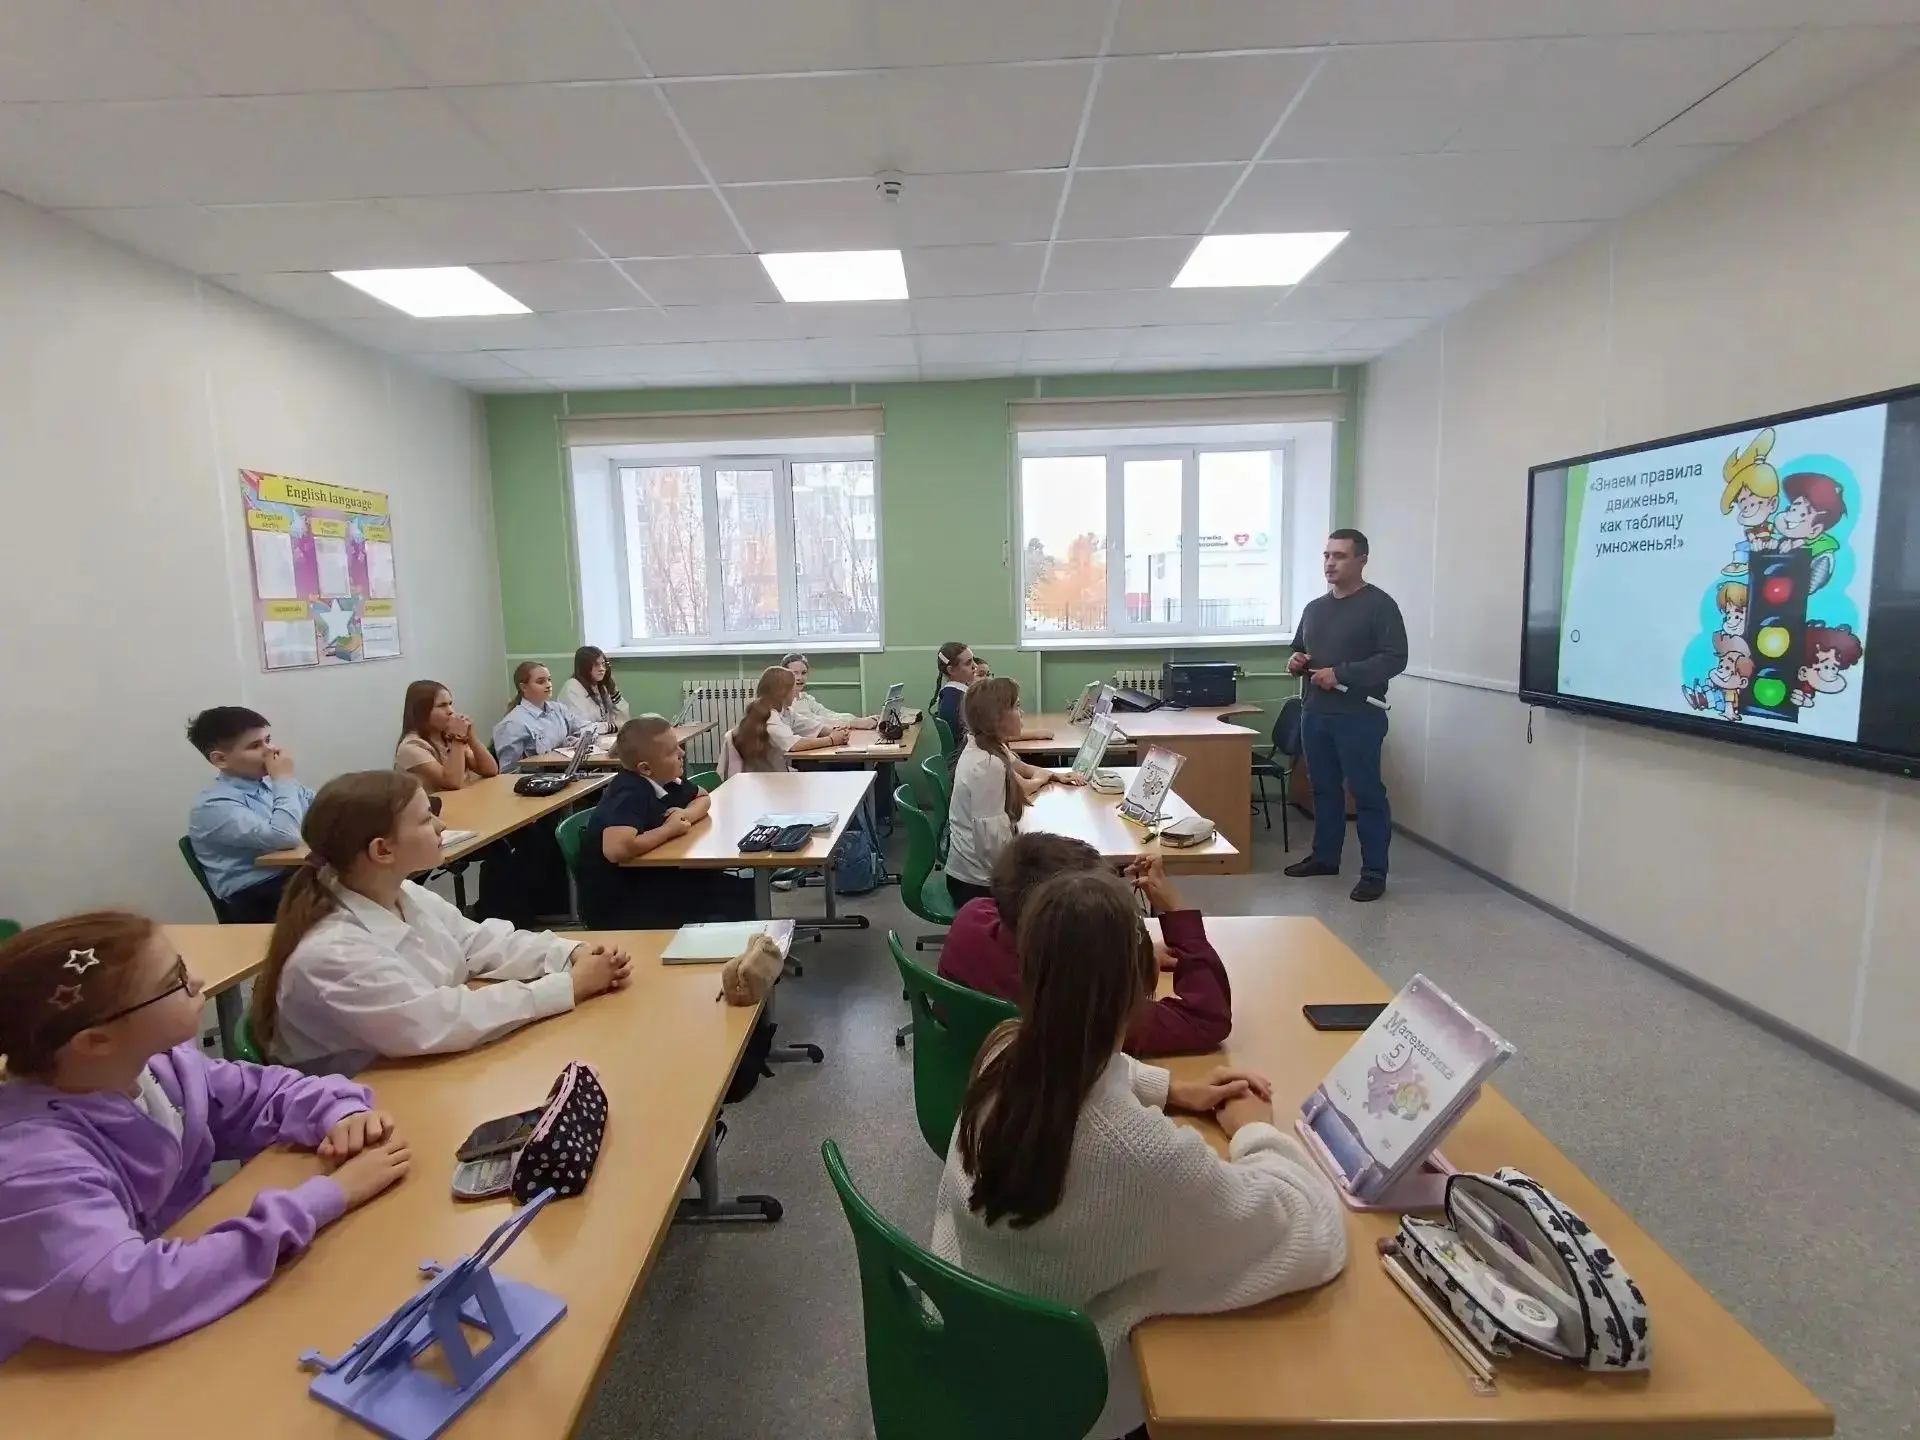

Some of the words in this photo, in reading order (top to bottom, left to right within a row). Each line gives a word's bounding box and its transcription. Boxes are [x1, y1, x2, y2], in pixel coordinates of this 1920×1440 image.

[1589, 473, 1637, 492] «Знаем
[1640, 463, 1703, 488] правила
[286, 484, 327, 503] English
[329, 491, 372, 511] language
[1605, 491, 1679, 514] движенья,
[1599, 518, 1622, 533] как
[1625, 513, 1684, 532] таблицу
[1595, 534, 1685, 558] умноженья!»
[1382, 1010, 1454, 1080] Математика
[1388, 1042, 1405, 1060] 5
